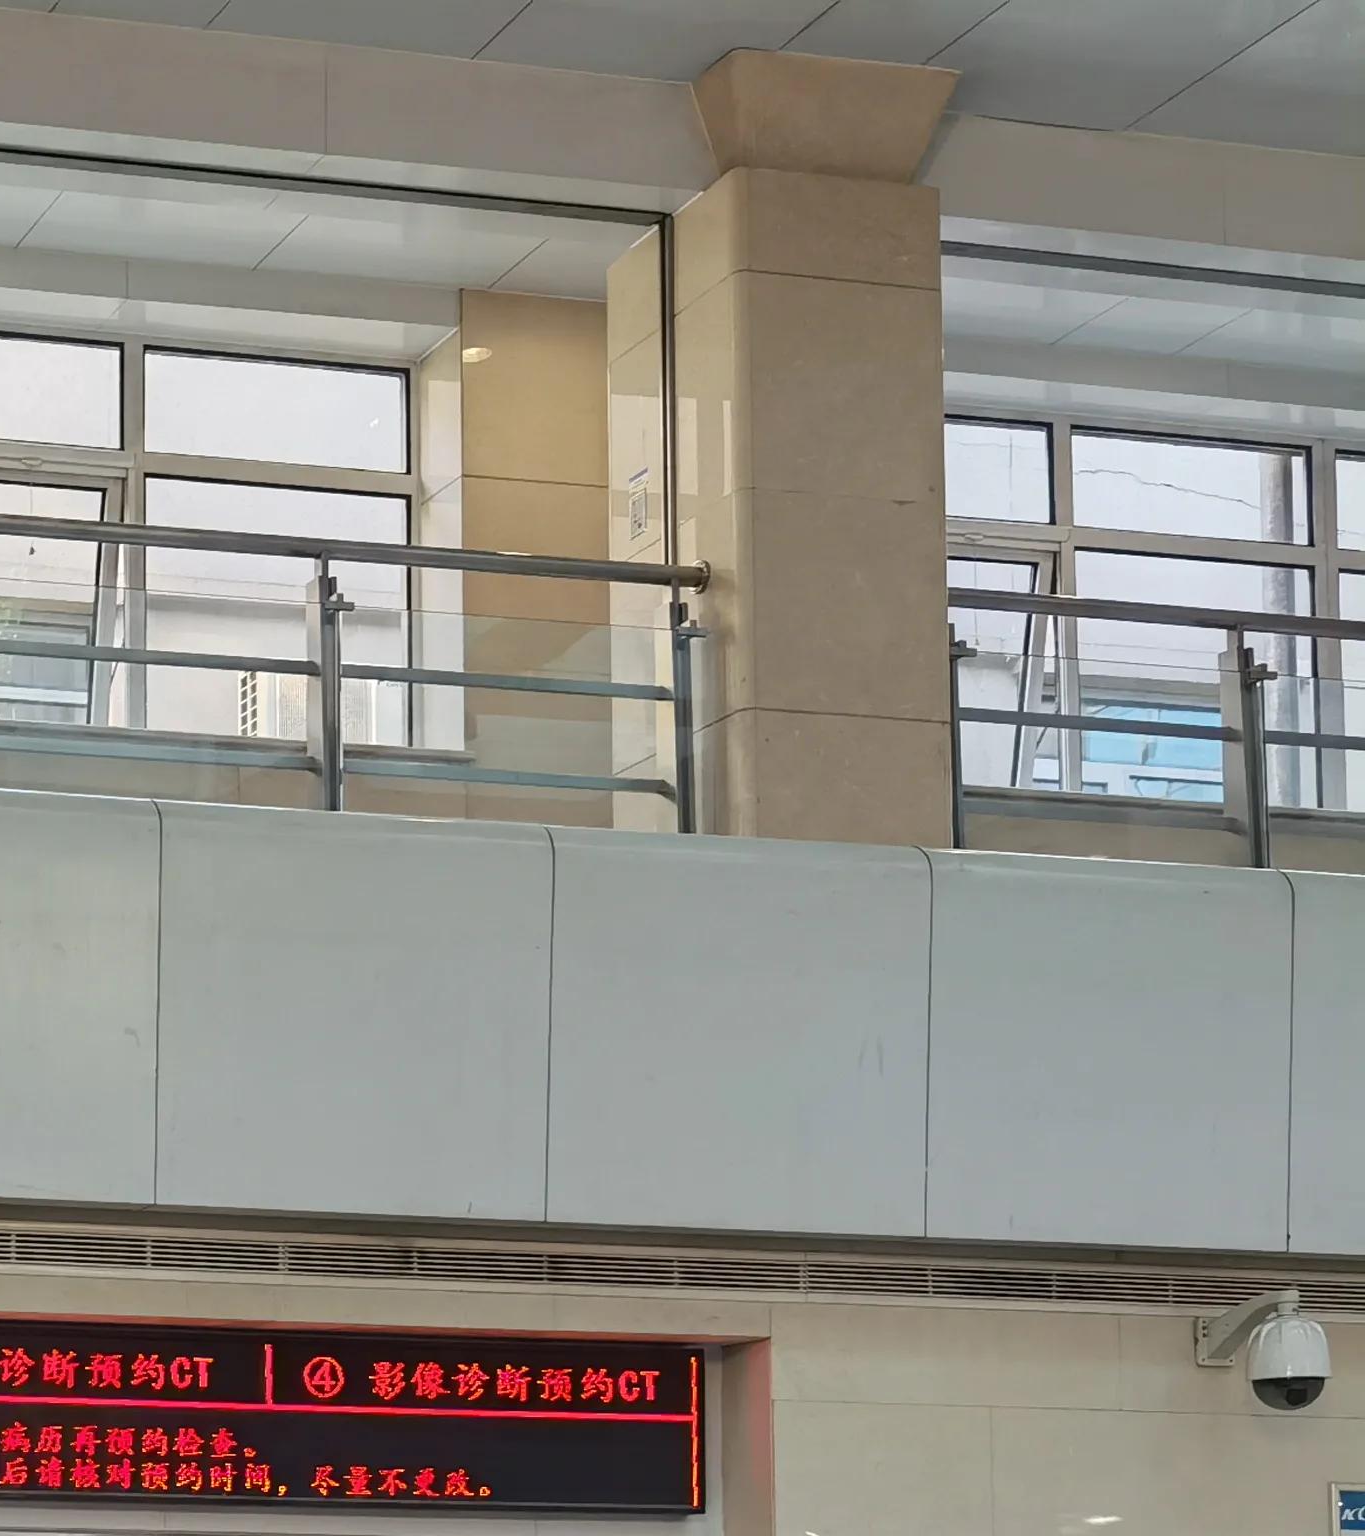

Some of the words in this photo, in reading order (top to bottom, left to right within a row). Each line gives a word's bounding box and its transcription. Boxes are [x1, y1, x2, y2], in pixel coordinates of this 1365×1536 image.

[368, 1361, 661, 1403] 影像诊断预约CT
